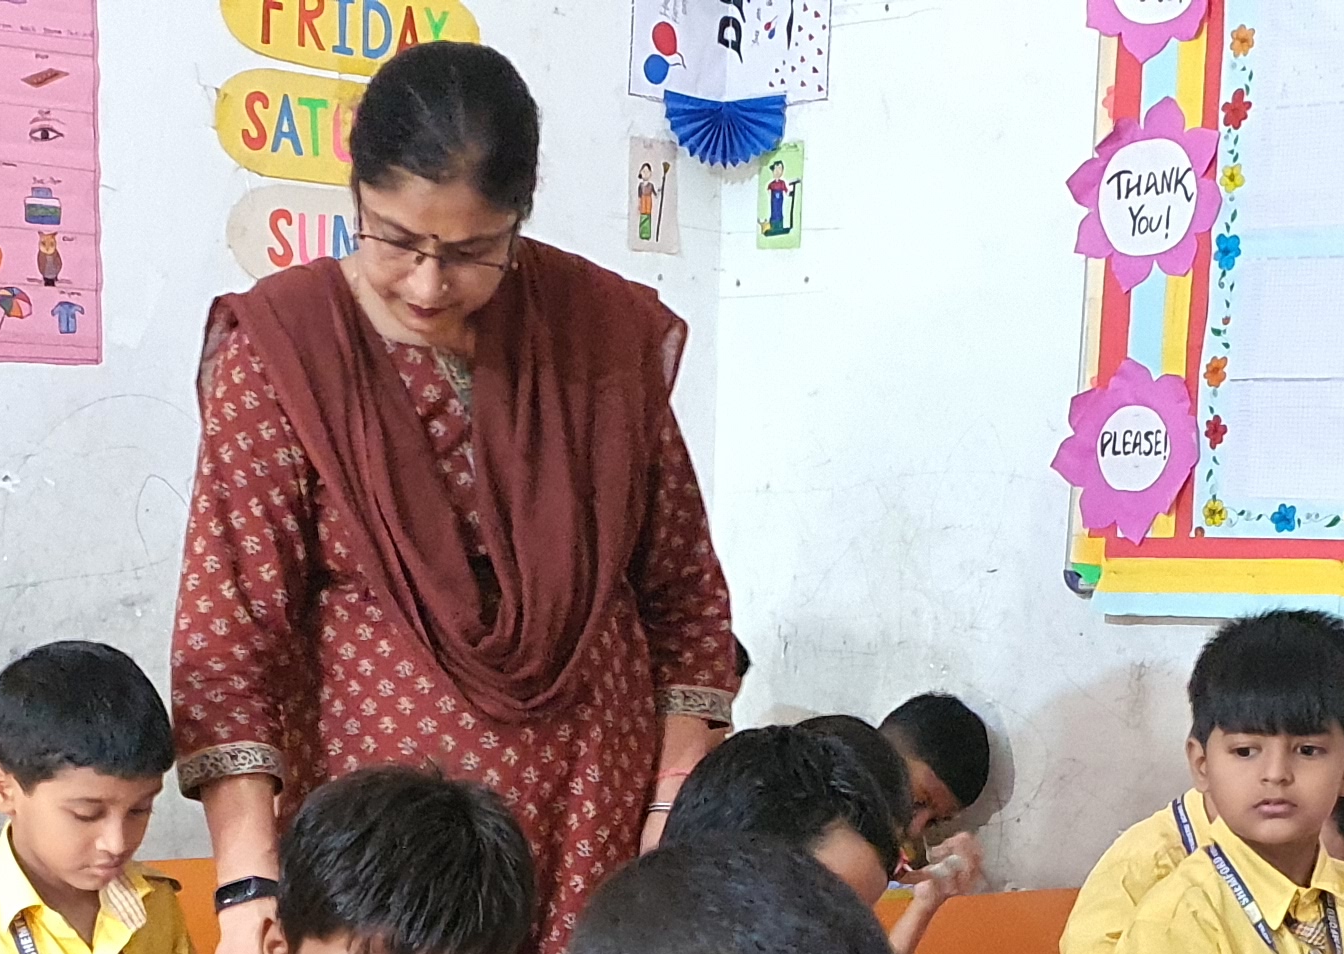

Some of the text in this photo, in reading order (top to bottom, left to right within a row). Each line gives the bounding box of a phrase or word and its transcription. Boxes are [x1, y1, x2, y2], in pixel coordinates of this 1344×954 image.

[1106, 166, 1194, 202] THANK
[1100, 429, 1168, 460] PLEASE!
[1213, 856, 1250, 906] SHEMFORD
